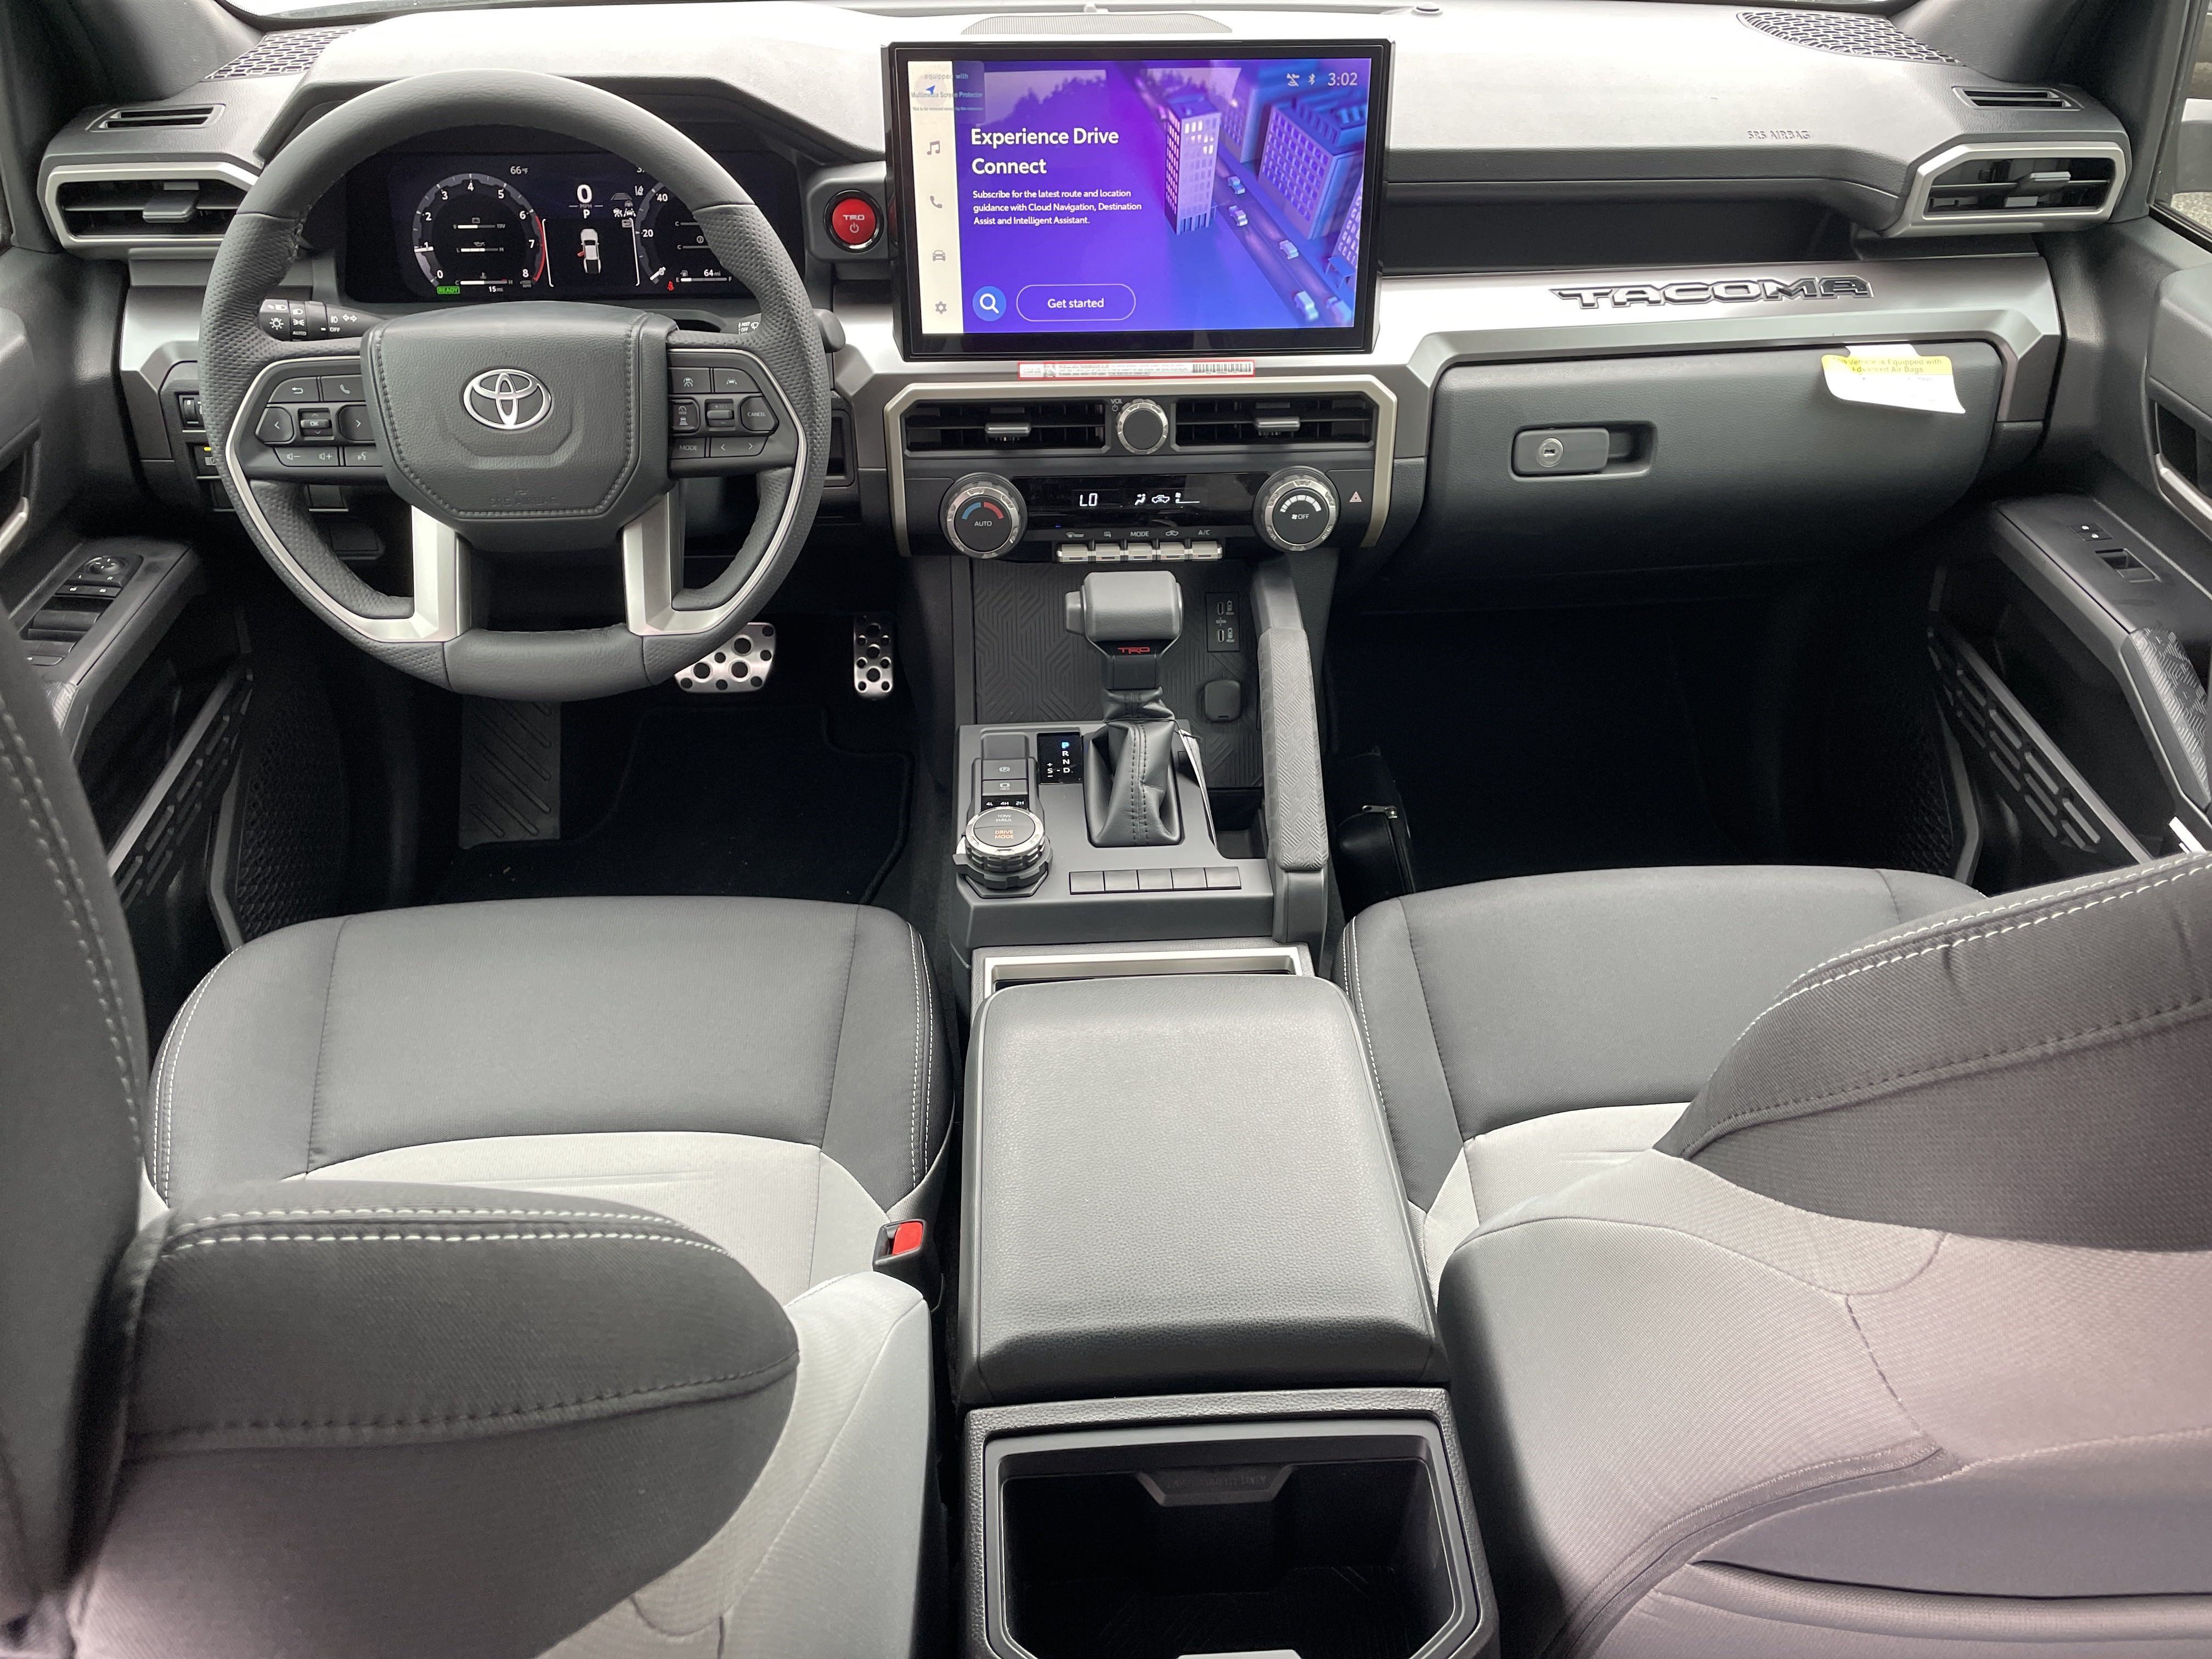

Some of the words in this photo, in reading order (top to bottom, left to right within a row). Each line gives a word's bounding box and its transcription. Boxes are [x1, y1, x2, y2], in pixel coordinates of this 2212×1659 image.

[1328, 72, 1358, 86] 3:02
[971, 128, 1069, 149] Experience
[1074, 127, 1119, 144] Drive
[1747, 131, 1767, 139] SRS
[1770, 130, 1810, 139] AIRBAG
[972, 158, 1047, 174] Connect
[467, 182, 474, 191] 4
[442, 191, 448, 200] 3
[498, 190, 504, 199] 5
[577, 184, 592, 204] 0
[657, 193, 668, 202] 40
[973, 190, 1011, 199] Subscribe
[1099, 189, 1131, 198] location
[973, 204, 1009, 213] guidance
[1053, 203, 1097, 213] Navigation,
[1098, 202, 1142, 211] Destination
[425, 212, 432, 221] 2
[519, 211, 526, 219] 6
[583, 209, 590, 218] P
[974, 217, 996, 225] Assist
[1013, 216, 1052, 227] Intelligent
[1053, 216, 1090, 225] Assistant.
[529, 239, 535, 249] 7
[437, 269, 443, 278] 0
[522, 269, 529, 278] 8
[1548, 274, 1875, 309] TACOMA
[1047, 298, 1066, 308] Get
[1069, 298, 1104, 308] started
[1080, 493, 1098, 506] LO
